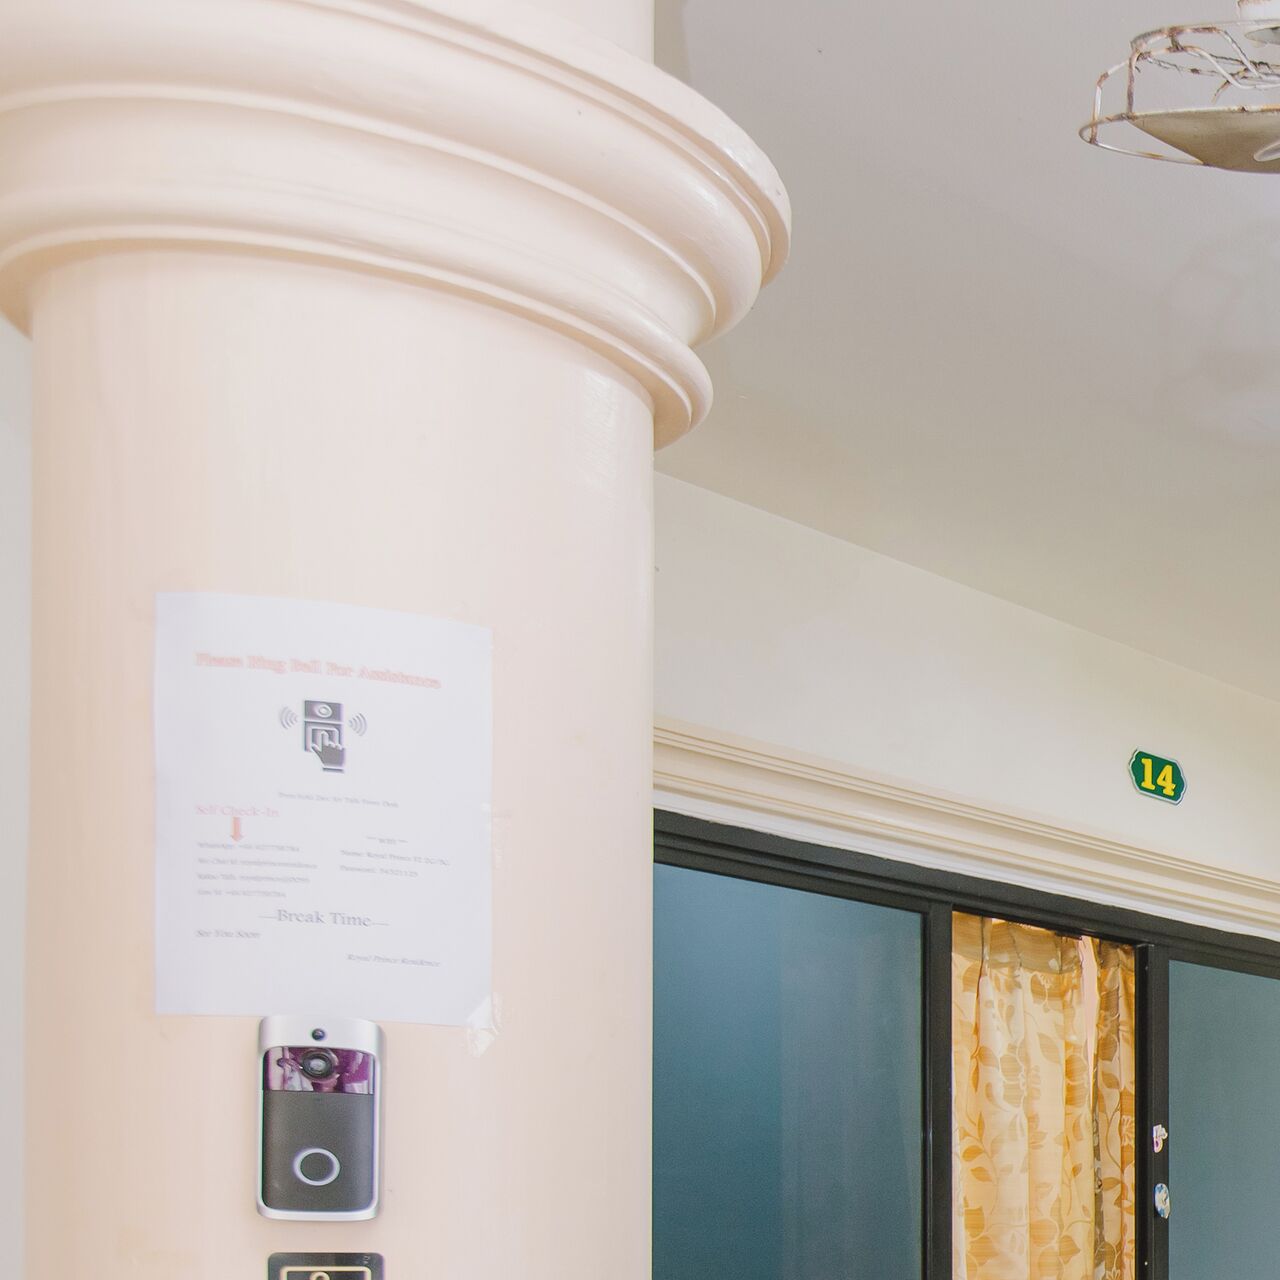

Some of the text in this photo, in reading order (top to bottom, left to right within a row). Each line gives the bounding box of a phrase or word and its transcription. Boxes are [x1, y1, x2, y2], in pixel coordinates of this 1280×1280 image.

[194, 652, 243, 667] Please
[248, 656, 286, 674] Ring
[290, 659, 321, 673] Bell
[327, 661, 354, 677] For
[1141, 758, 1176, 797] 14
